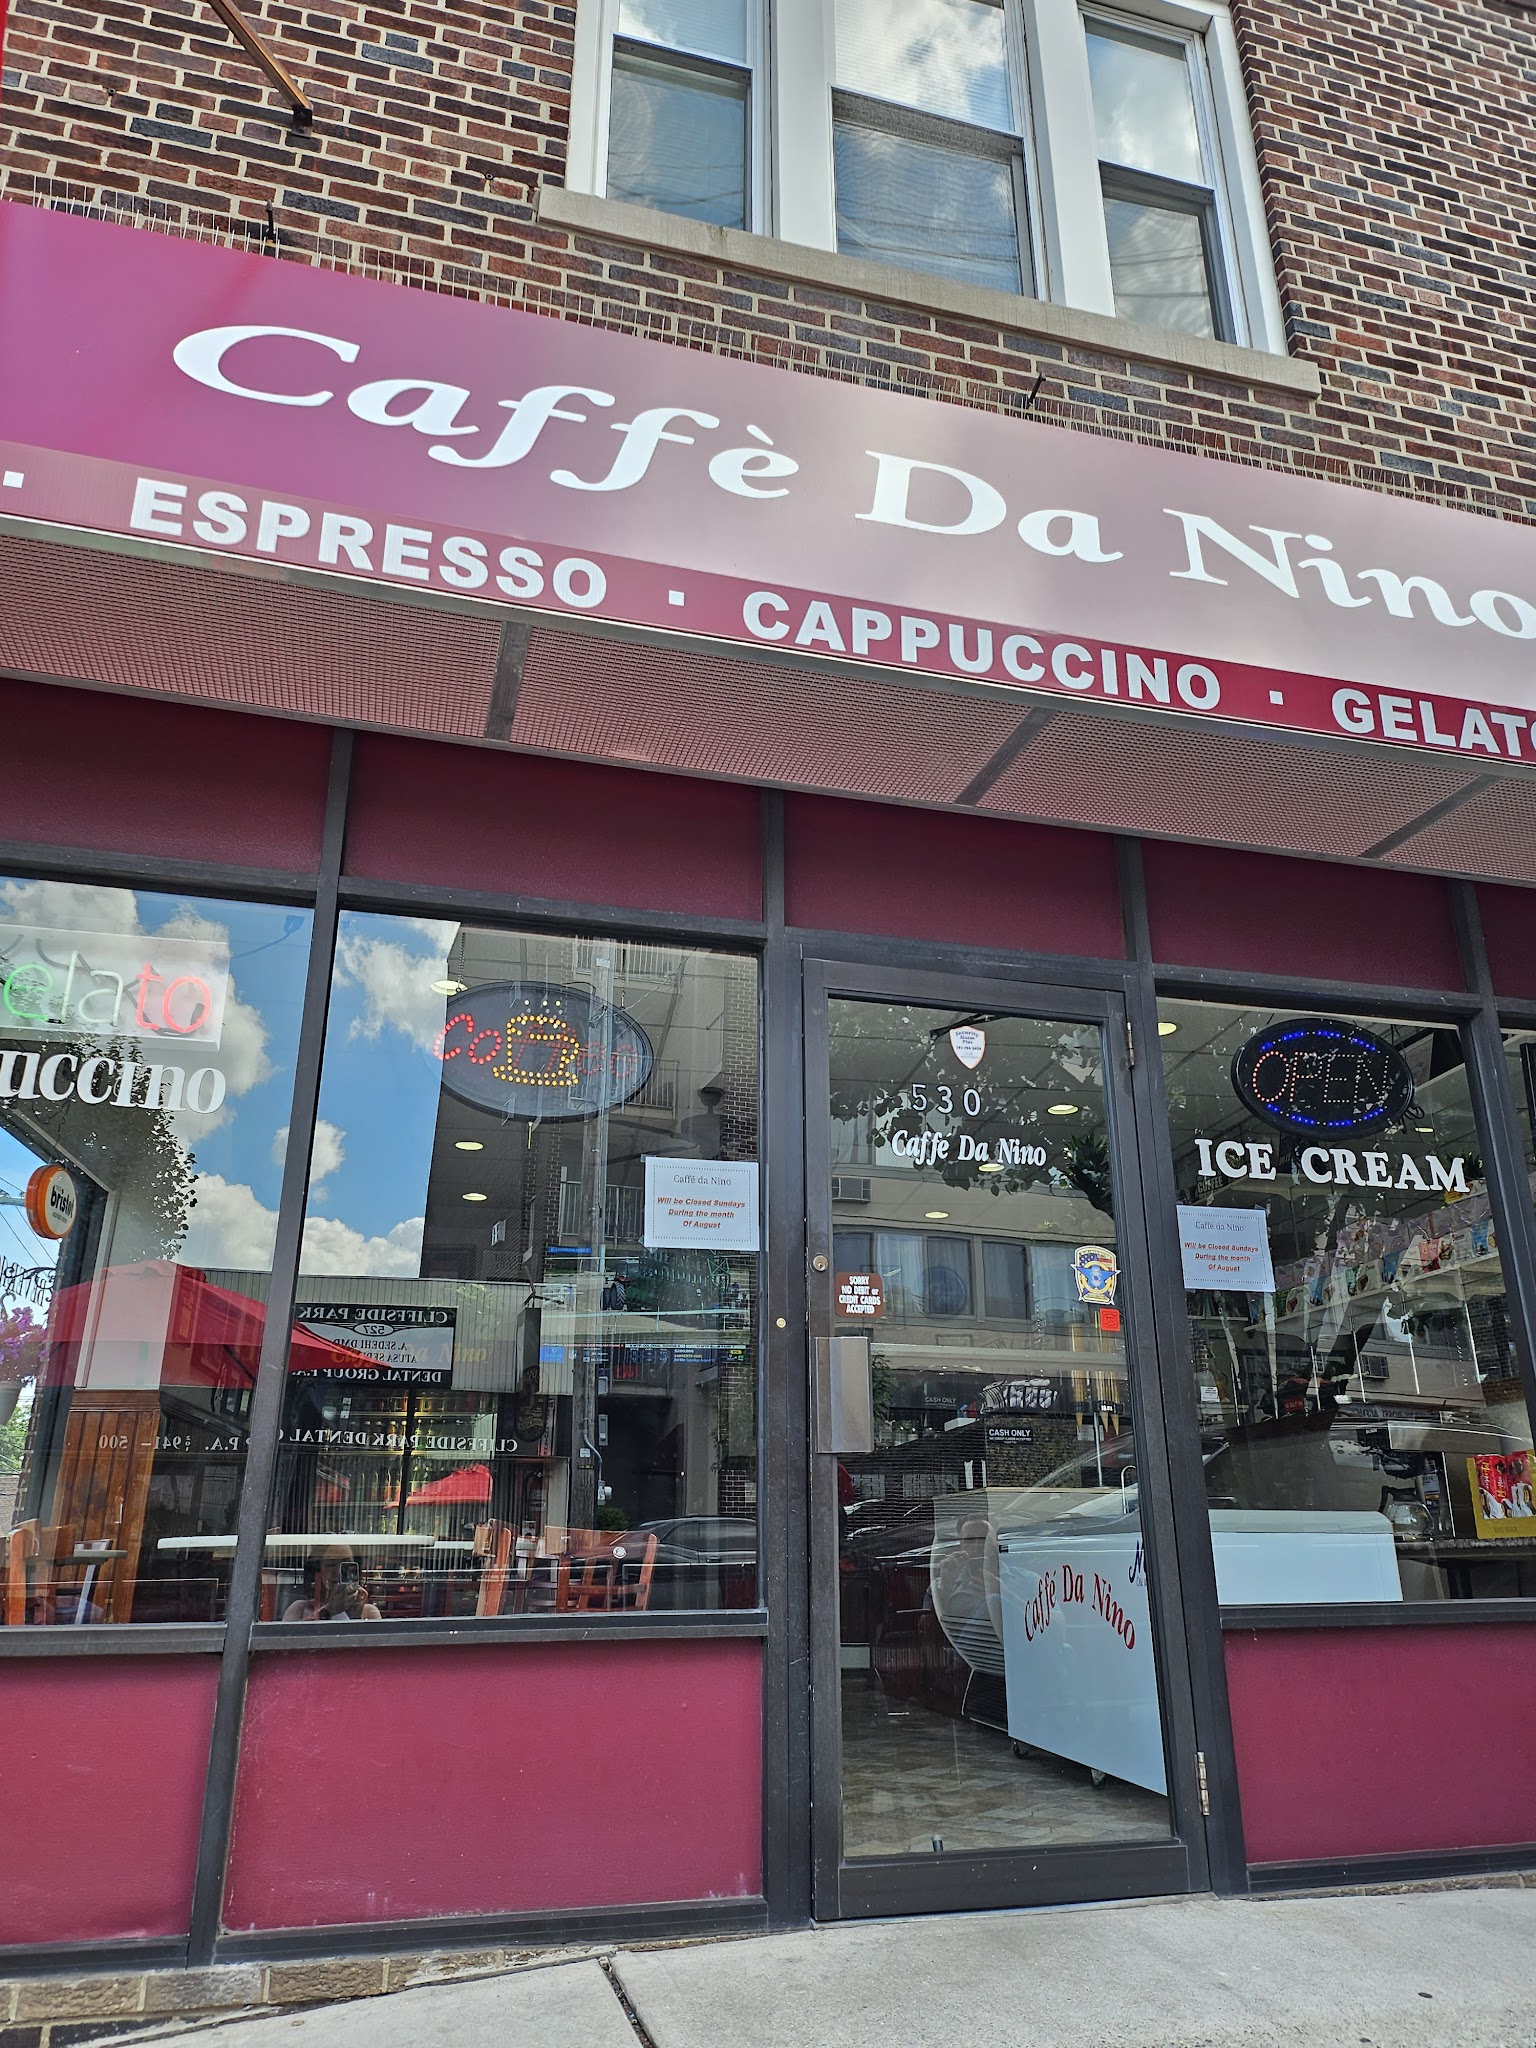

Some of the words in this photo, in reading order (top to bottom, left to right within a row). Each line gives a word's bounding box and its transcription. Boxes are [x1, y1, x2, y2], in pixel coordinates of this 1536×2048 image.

[173, 325, 800, 498] Caffè
[855, 450, 1124, 563] Da
[1162, 509, 1536, 639] Nino
[130, 477, 607, 608] ESPRESSO
[743, 591, 1221, 710] CAPPUCCINO
[1332, 688, 1536, 758] GELAT
[1252, 1050, 1389, 1103] OPEN
[911, 1083, 981, 1117] 530
[957, 1135, 989, 1162] Da
[996, 1137, 1047, 1166] Nino
[1194, 1139, 1277, 1181] ICE
[1301, 1147, 1471, 1193] CREAM
[697, 1175, 709, 1185] da
[710, 1176, 732, 1186] Nino
[685, 1198, 711, 1206] Closed
[713, 1199, 745, 1209] Sundays
[668, 1209, 693, 1217] During
[693, 1221, 721, 1229] August
[1215, 1223, 1225, 1231] da
[1226, 1223, 1245, 1232] Nino
[1231, 1244, 1259, 1253] Sundays
[1195, 1252, 1216, 1260] During
[1217, 1264, 1240, 1272] August
[849, 1276, 870, 1285] SORRY
[841, 1285, 853, 1295] NO
[853, 1286, 870, 1295] DEBIT
[839, 1295, 859, 1304] CREDIT
[860, 1295, 881, 1306] CARDS
[846, 1304, 875, 1314] ACCEPTED
[988, 1428, 1010, 1437] CASH
[1011, 1429, 1031, 1438] ONLY
[1024, 1569, 1057, 1642] Caffé
[1062, 1564, 1085, 1604] Da
[1092, 1572, 1135, 1650] Nino
